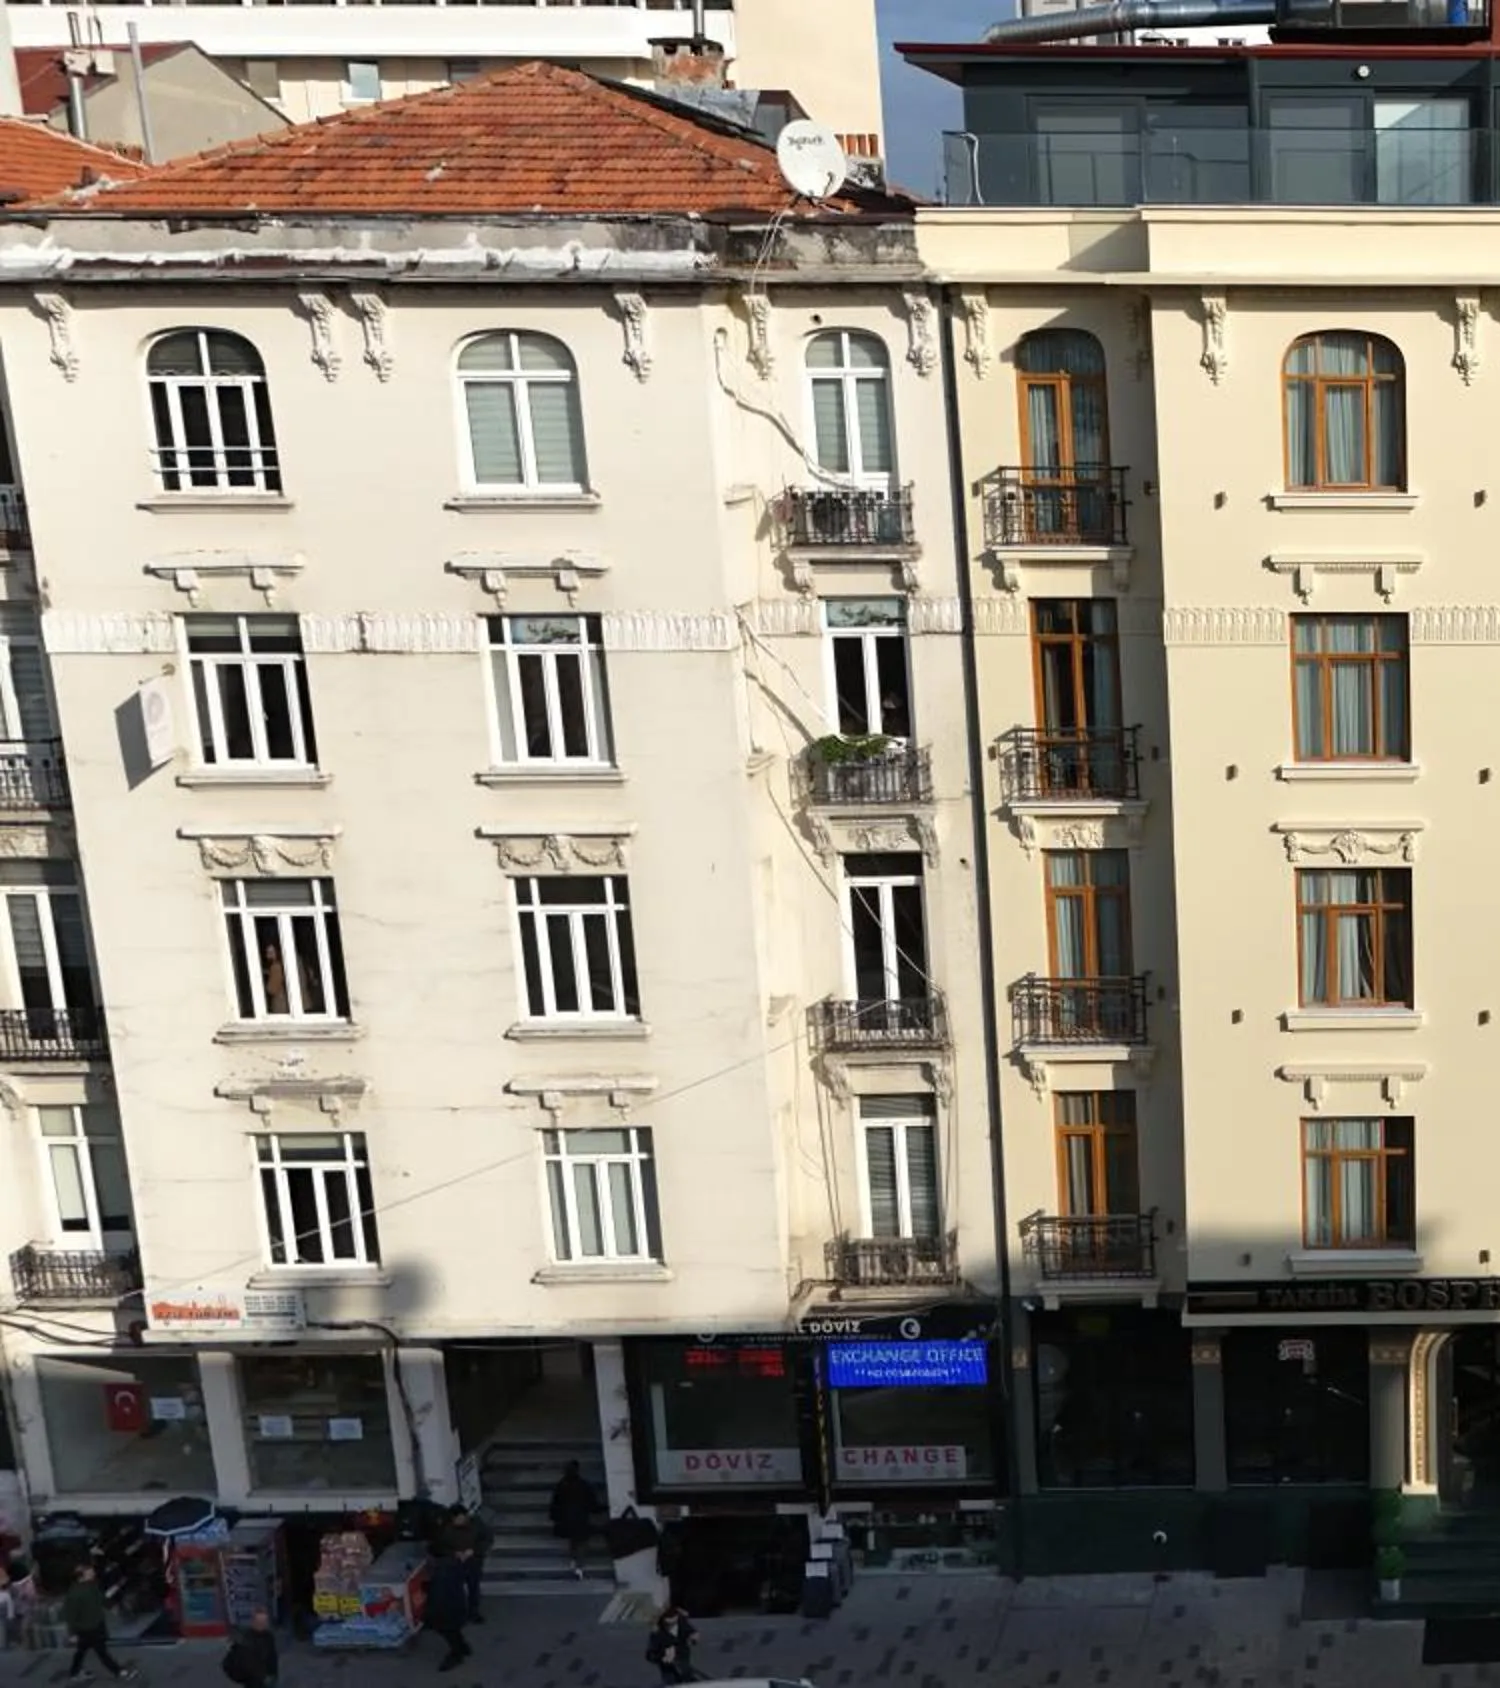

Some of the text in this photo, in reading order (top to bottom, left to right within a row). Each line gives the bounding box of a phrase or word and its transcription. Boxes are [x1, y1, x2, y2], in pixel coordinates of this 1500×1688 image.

[810, 1319, 862, 1333] DÖVİZ
[831, 1347, 984, 1365] EXCHANGE OFFICE
[685, 1452, 773, 1471] DÖVİZ
[844, 1448, 958, 1465] CHANGE
